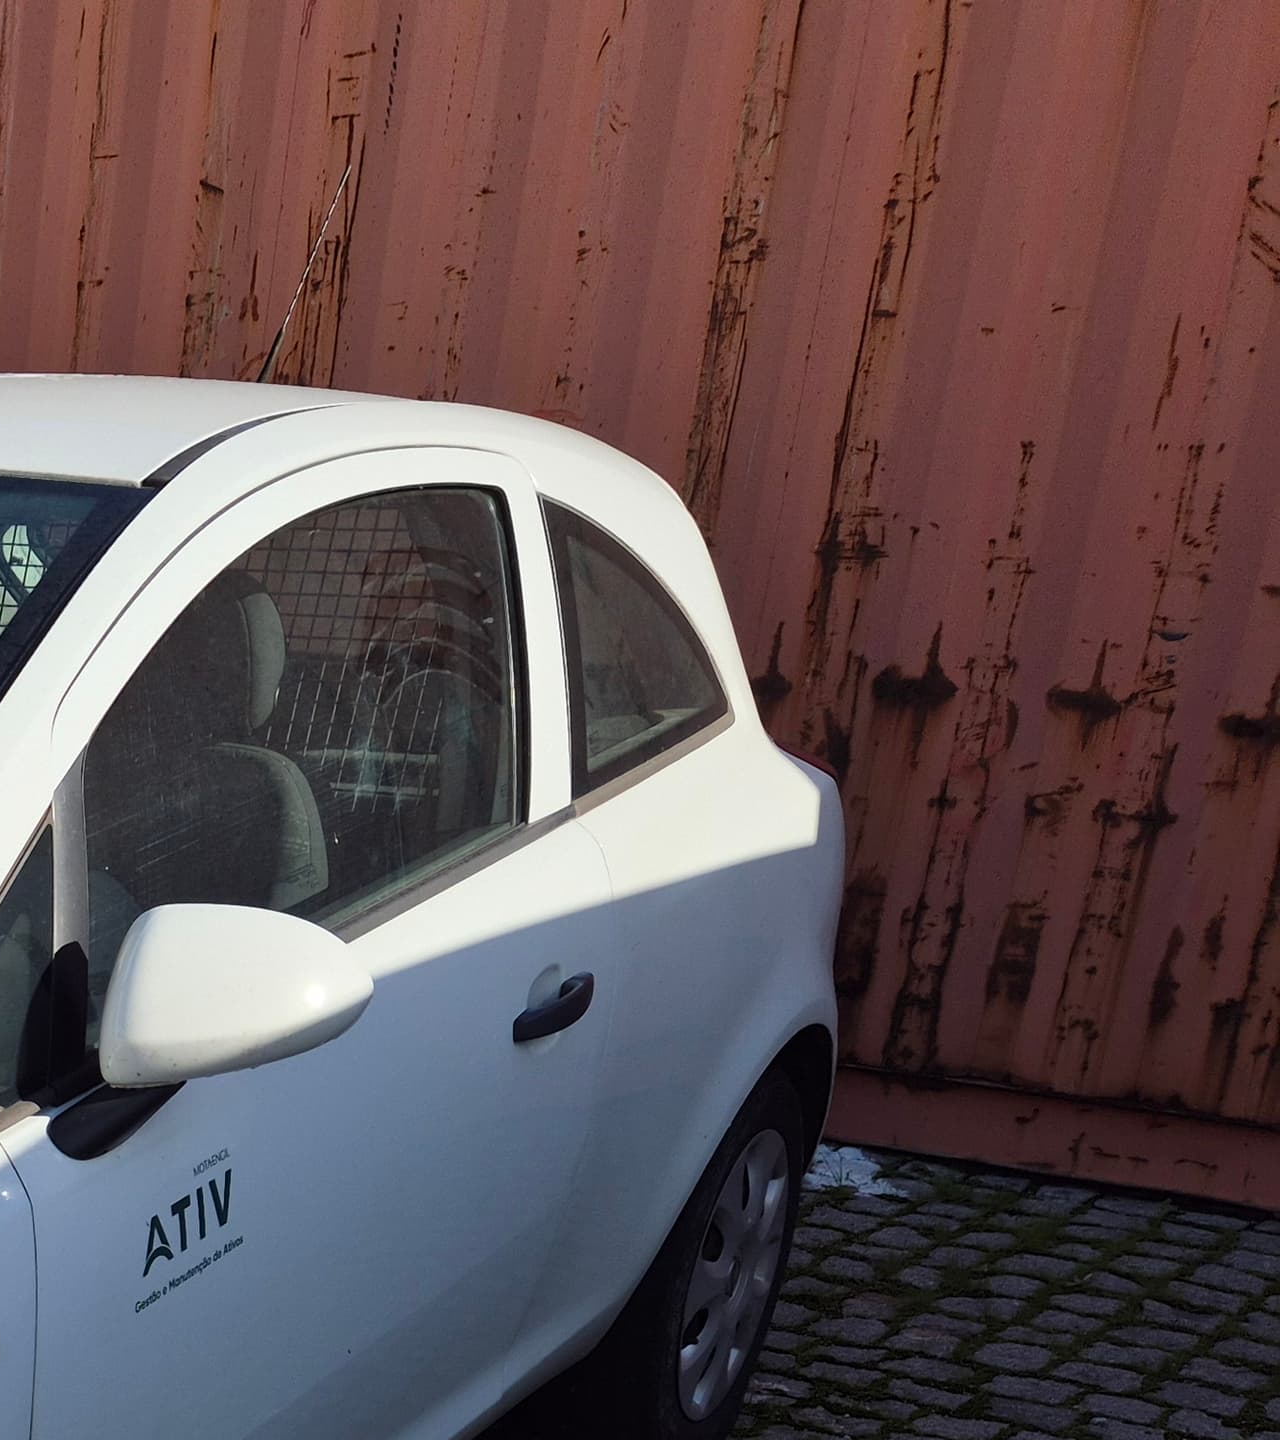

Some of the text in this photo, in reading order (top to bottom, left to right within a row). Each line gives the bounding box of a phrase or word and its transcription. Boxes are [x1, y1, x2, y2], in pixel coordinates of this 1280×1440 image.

[142, 1168, 232, 1278] ATIV
[162, 1285, 168, 1296] e
[222, 1235, 244, 1256] Ativos
